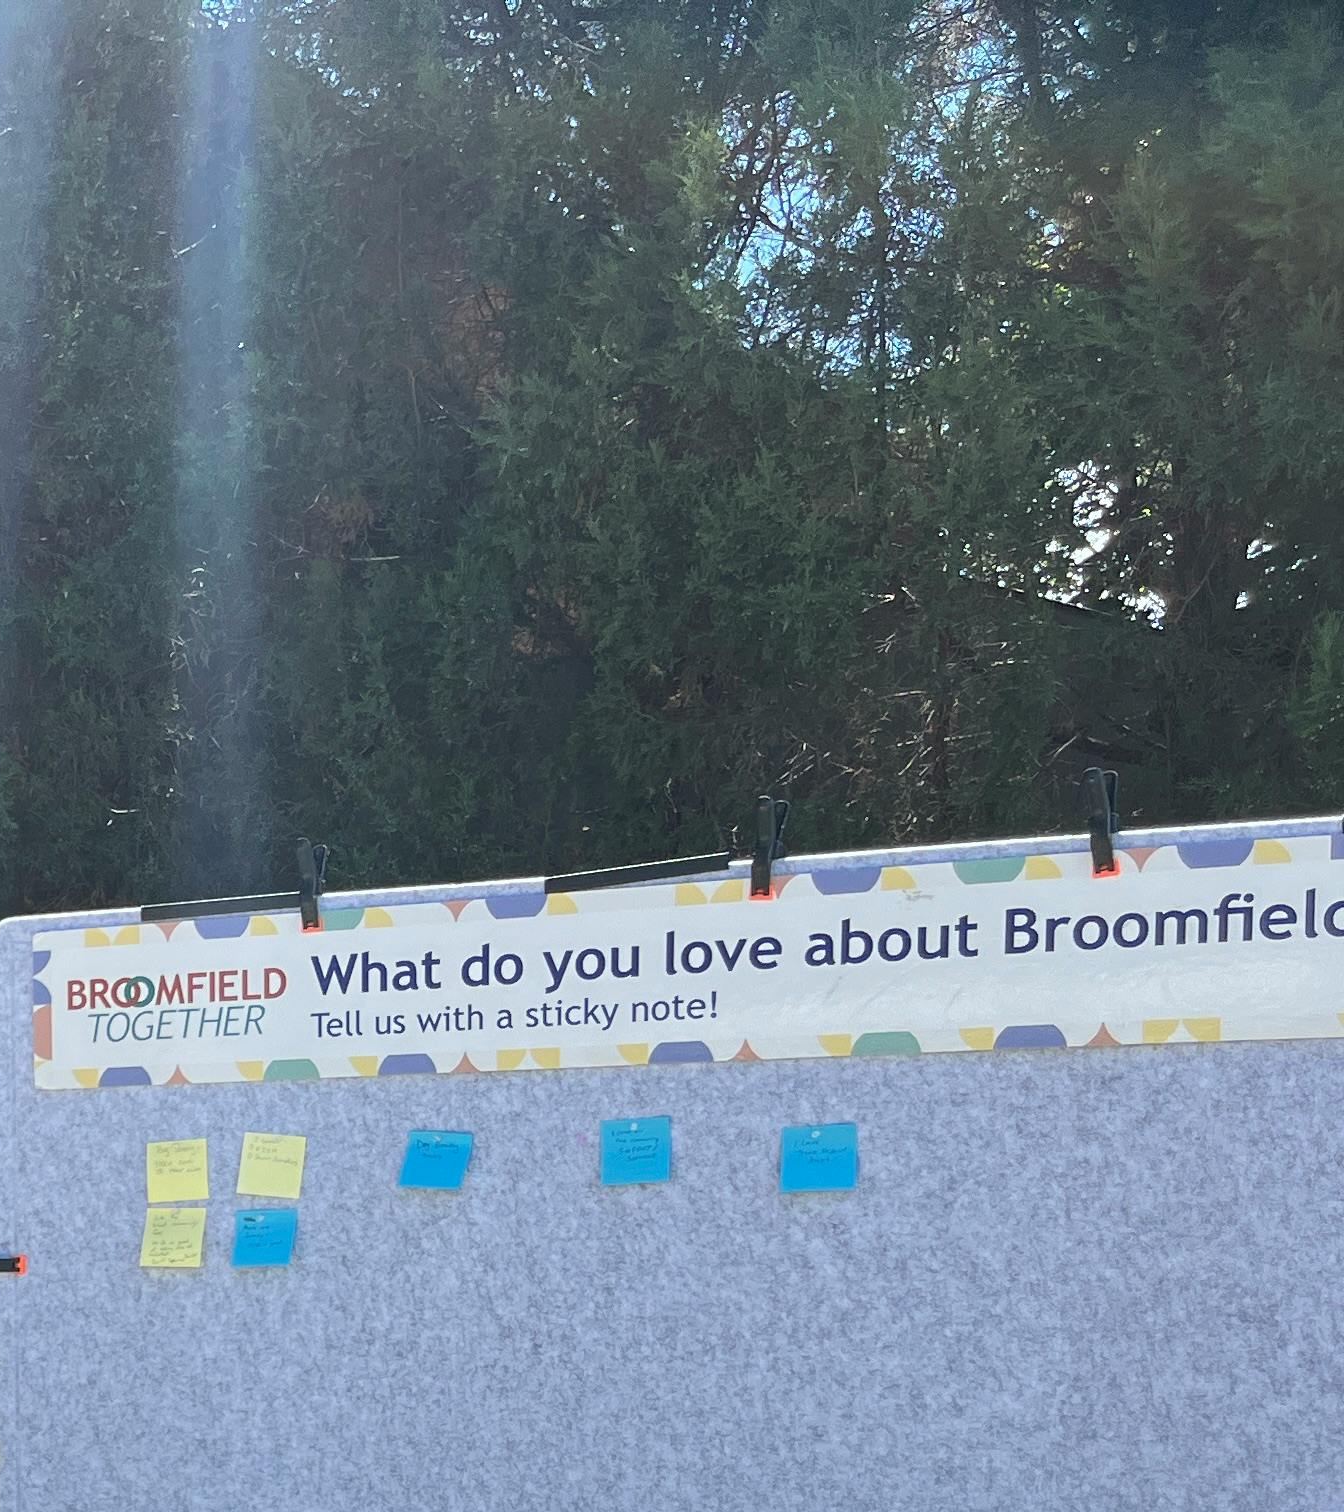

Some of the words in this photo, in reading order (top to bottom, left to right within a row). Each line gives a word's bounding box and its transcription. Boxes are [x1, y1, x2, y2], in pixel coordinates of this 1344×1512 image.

[311, 952, 441, 995] What
[462, 944, 523, 986] do
[543, 946, 639, 993] you
[666, 931, 782, 975] love
[805, 915, 978, 966] about
[67, 968, 286, 1011] BROOMFIELD
[88, 1003, 266, 1043] TOGETHER
[311, 1010, 362, 1037] Tell
[376, 1015, 405, 1035] us
[417, 1005, 483, 1033] with
[497, 1010, 514, 1029] a
[527, 998, 618, 1031] sticky
[632, 991, 716, 1023] note!
